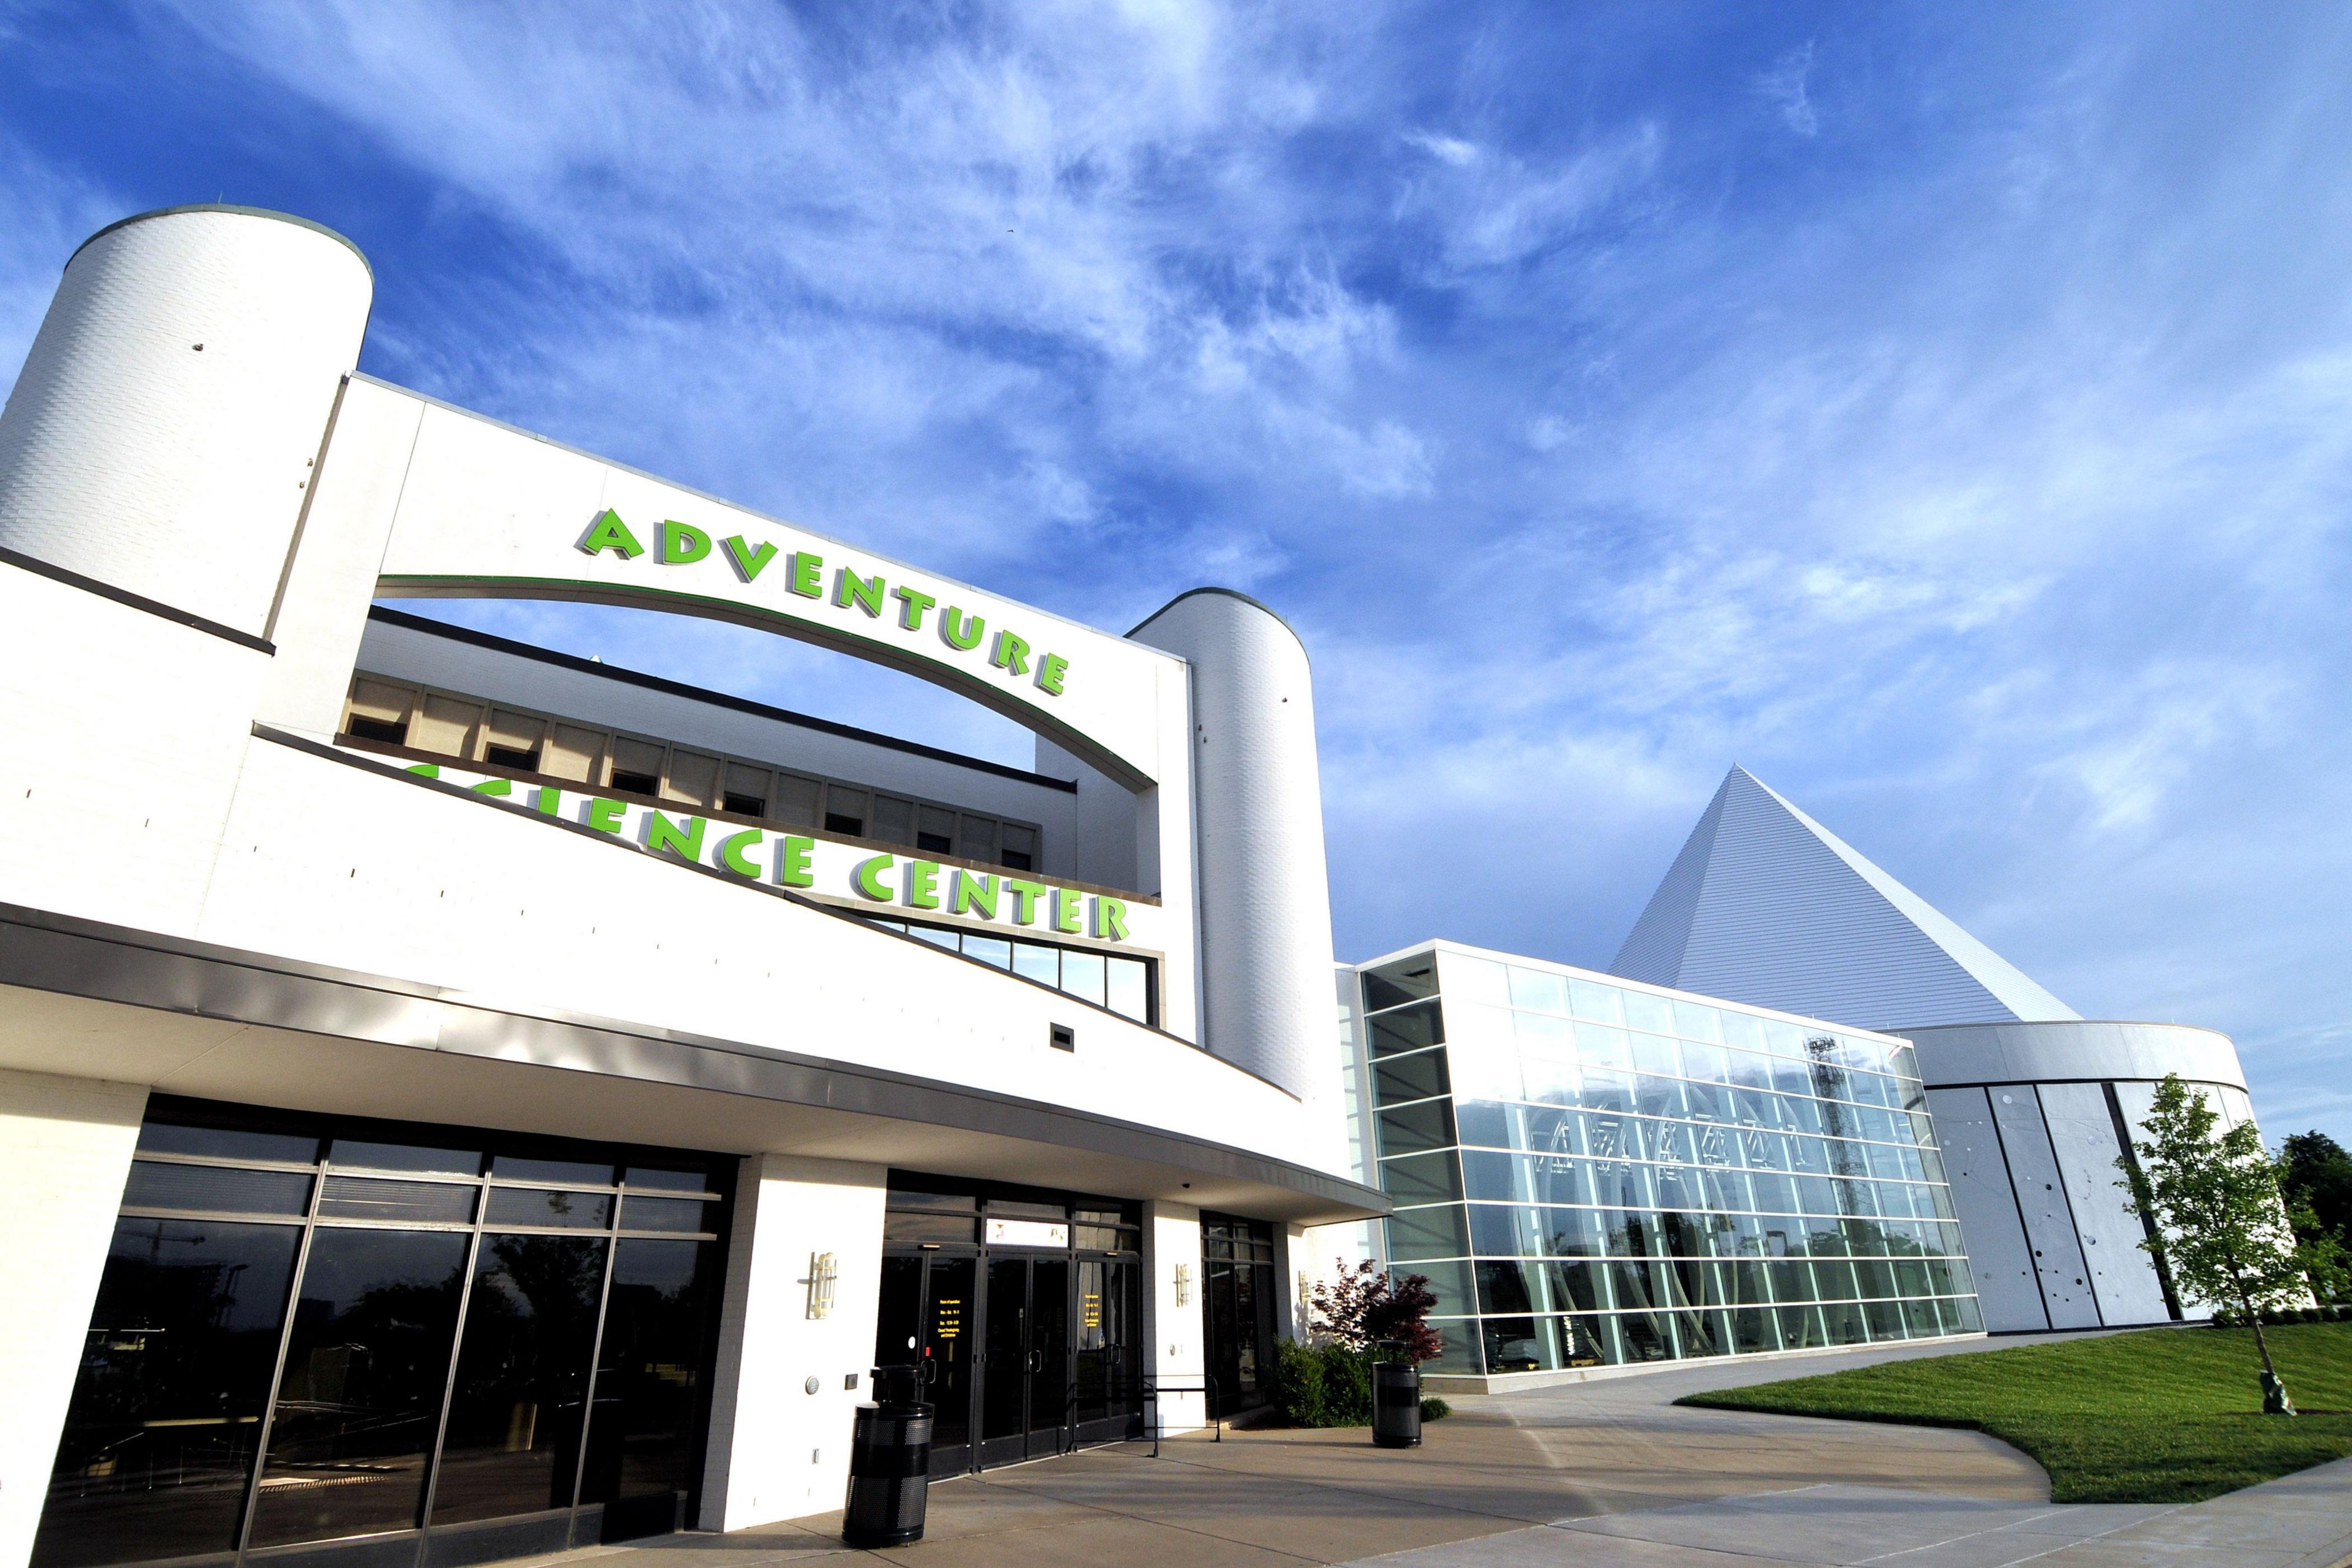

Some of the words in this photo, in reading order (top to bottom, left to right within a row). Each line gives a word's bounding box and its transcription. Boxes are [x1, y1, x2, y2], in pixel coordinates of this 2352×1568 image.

[583, 507, 1068, 696] ADVENTURE
[404, 764, 814, 887] IENCE
[857, 854, 1130, 941] CENTER
